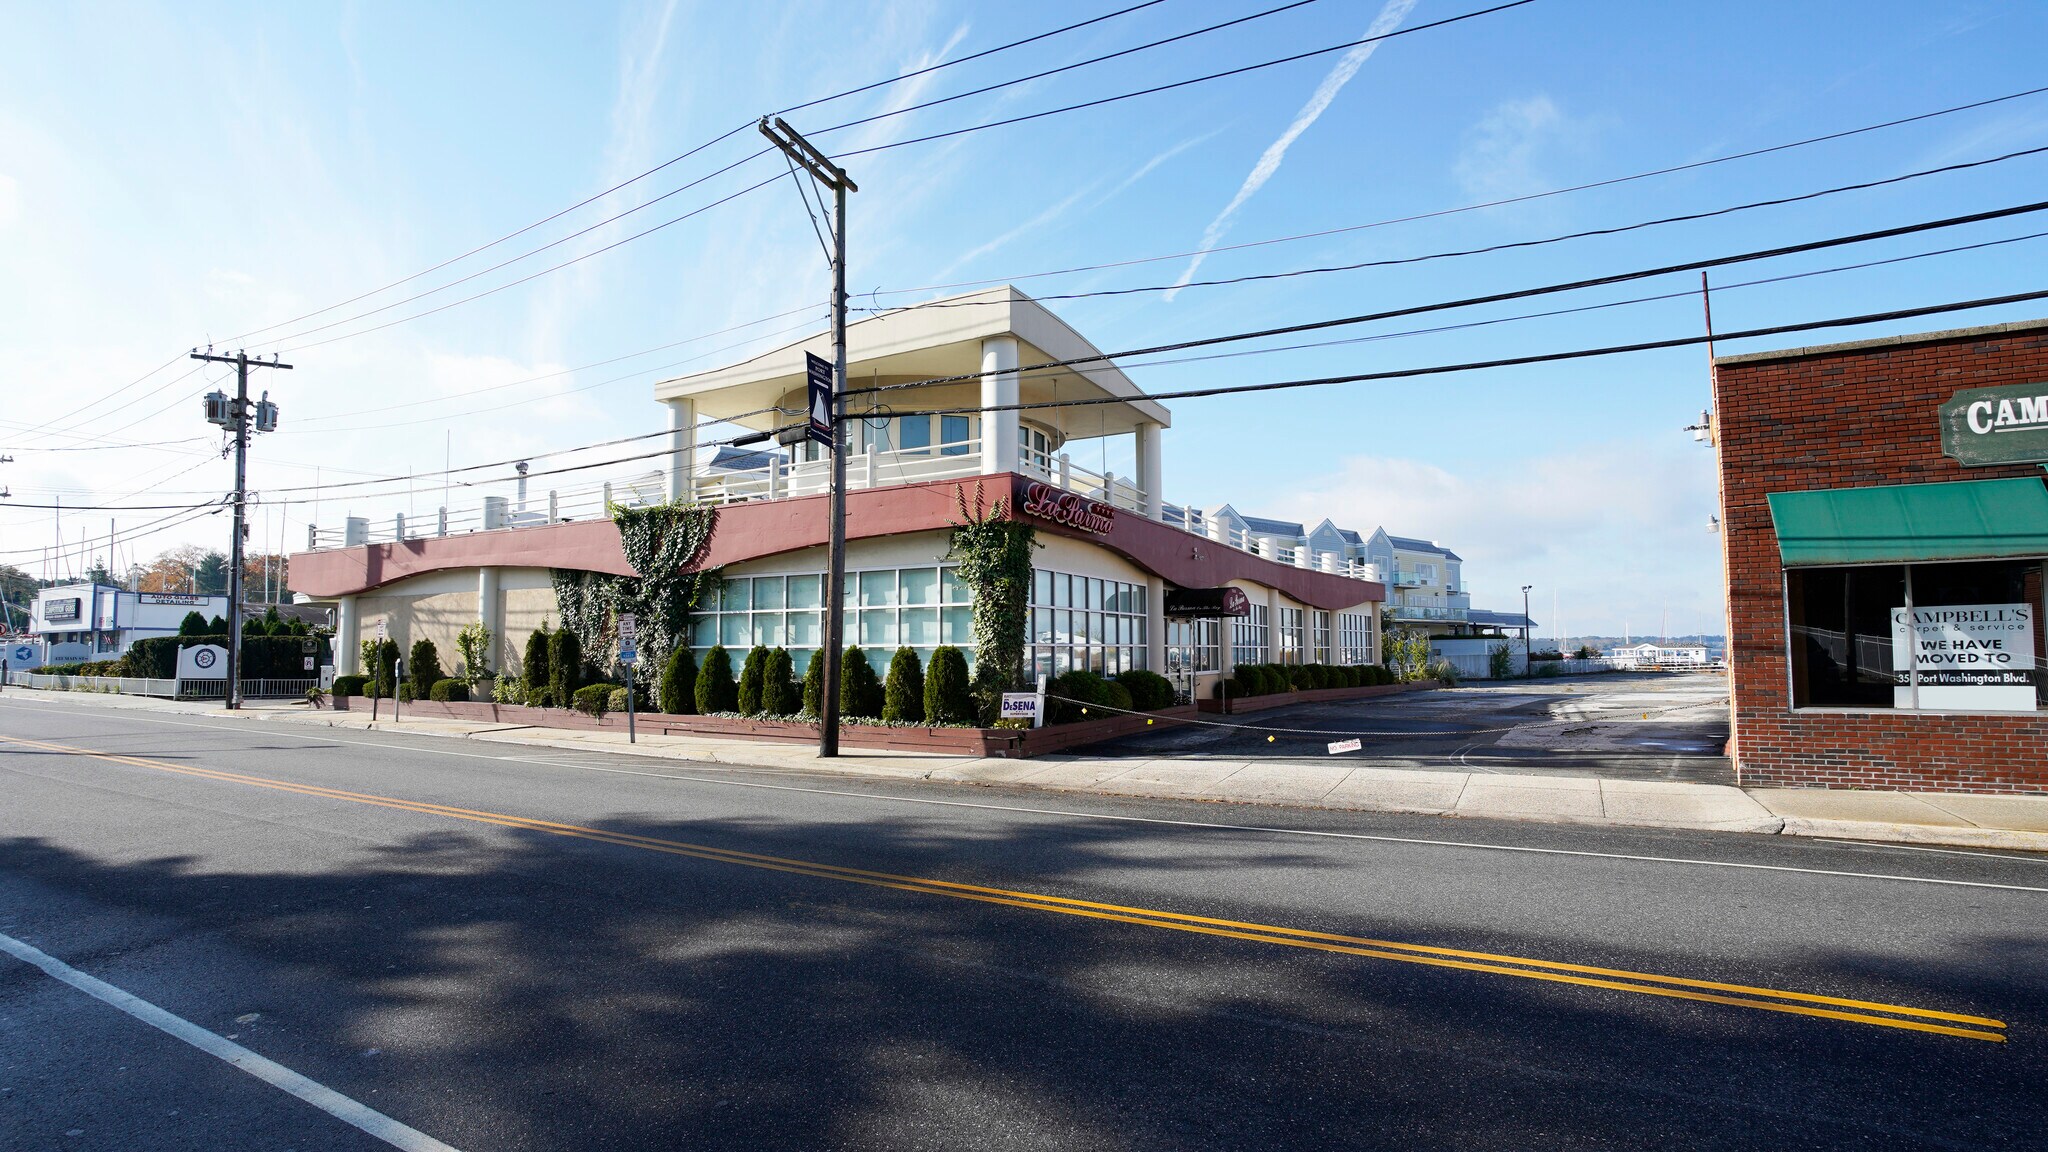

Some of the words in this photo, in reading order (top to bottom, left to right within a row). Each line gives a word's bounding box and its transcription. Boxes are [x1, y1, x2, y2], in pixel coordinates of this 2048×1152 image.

[1024, 482, 1060, 520] La
[1056, 493, 1114, 537] Parma
[1895, 609, 2029, 624] CAMPBELL'S
[1899, 624, 1945, 634] crpet
[1953, 623, 1961, 632] &
[1969, 623, 2025, 632] service
[1920, 640, 1947, 651] WE
[1952, 639, 2002, 650] HAVE
[1915, 653, 1980, 664] MOVED
[1984, 653, 2011, 663] TO
[1917, 673, 1938, 683] Port
[1939, 673, 2001, 685] Washington
[2003, 672, 2030, 683] Blvd.
[1339, 741, 1360, 750] PARKING
